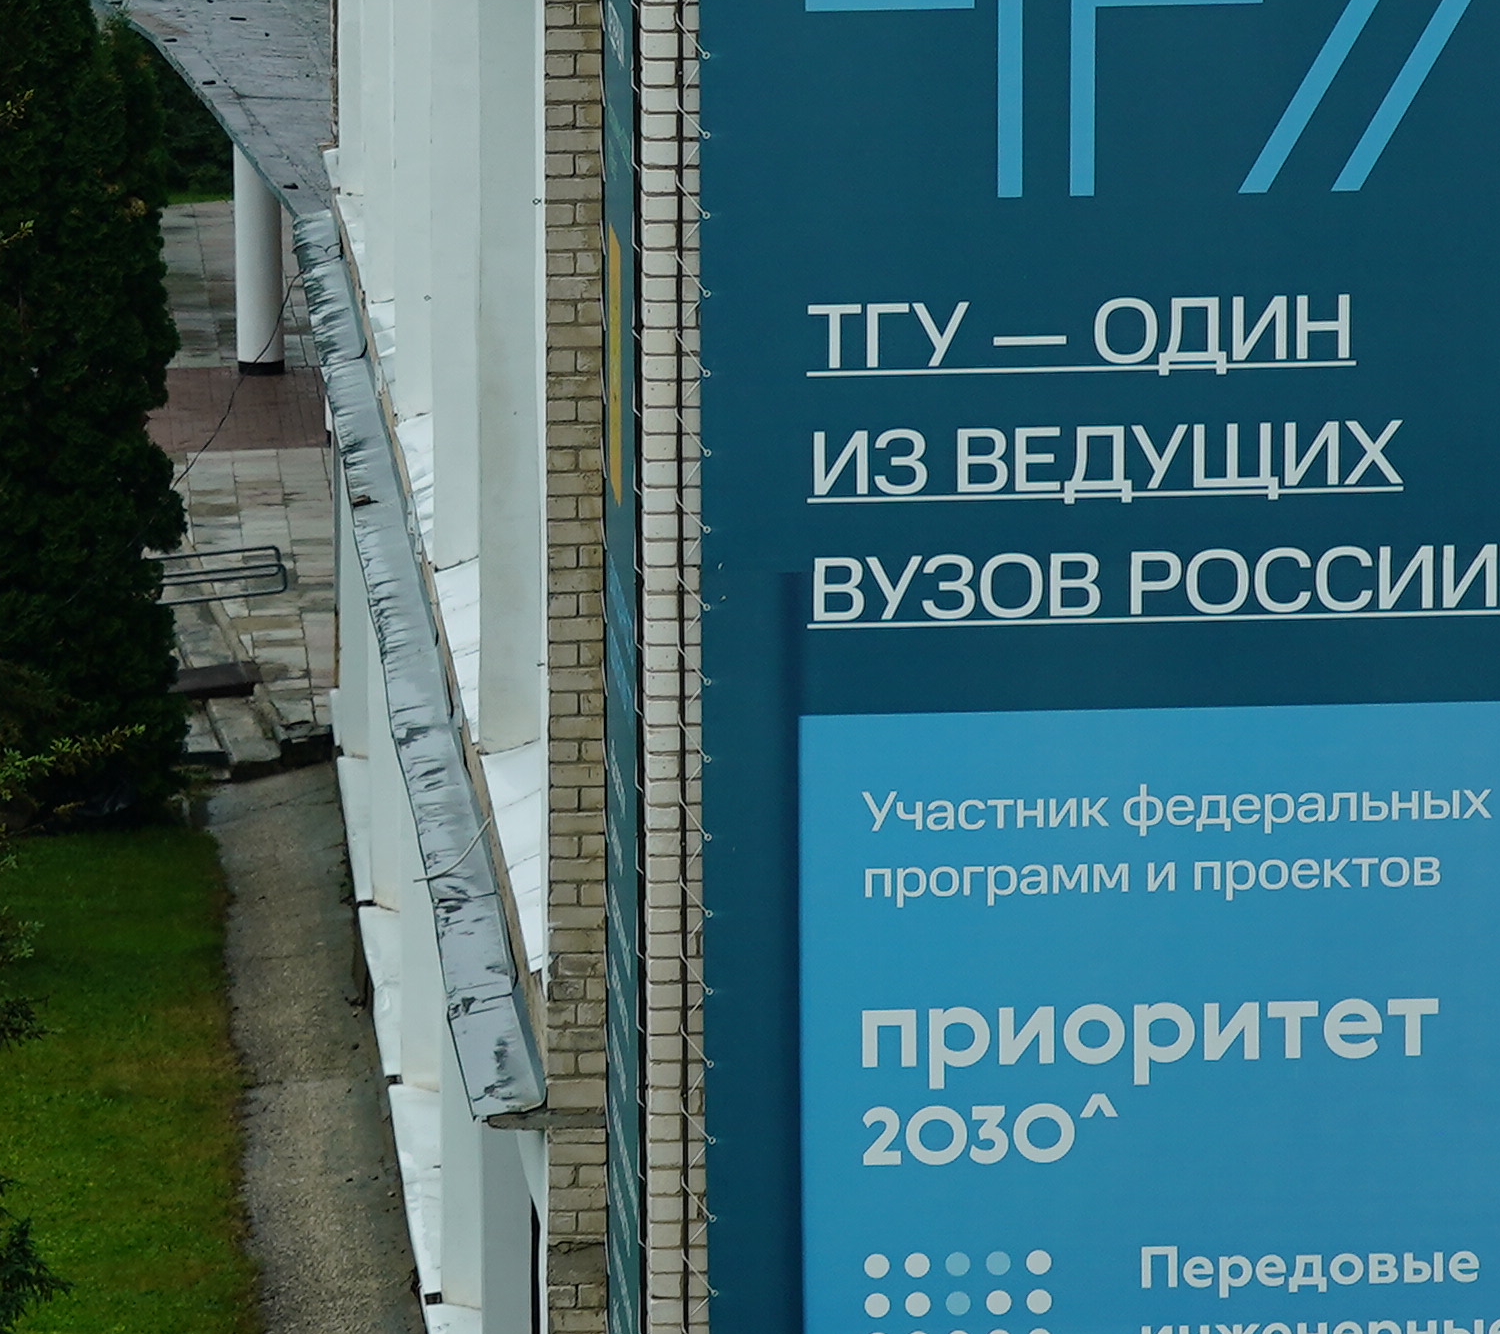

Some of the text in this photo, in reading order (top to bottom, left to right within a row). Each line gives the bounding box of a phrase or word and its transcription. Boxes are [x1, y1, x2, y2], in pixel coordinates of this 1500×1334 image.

[806, 301, 970, 370] ТГУ
[1092, 294, 1353, 375] ОДИН
[812, 419, 1404, 504] ИЗ ВЕДУЩИХ
[812, 543, 1500, 623] ВУЗОВ РОССИИ
[861, 783, 1493, 838] Участник федеральных
[864, 851, 1442, 909] программ и проектов
[861, 997, 1440, 1087] приоритет
[1140, 1245, 1480, 1298] Передовые
